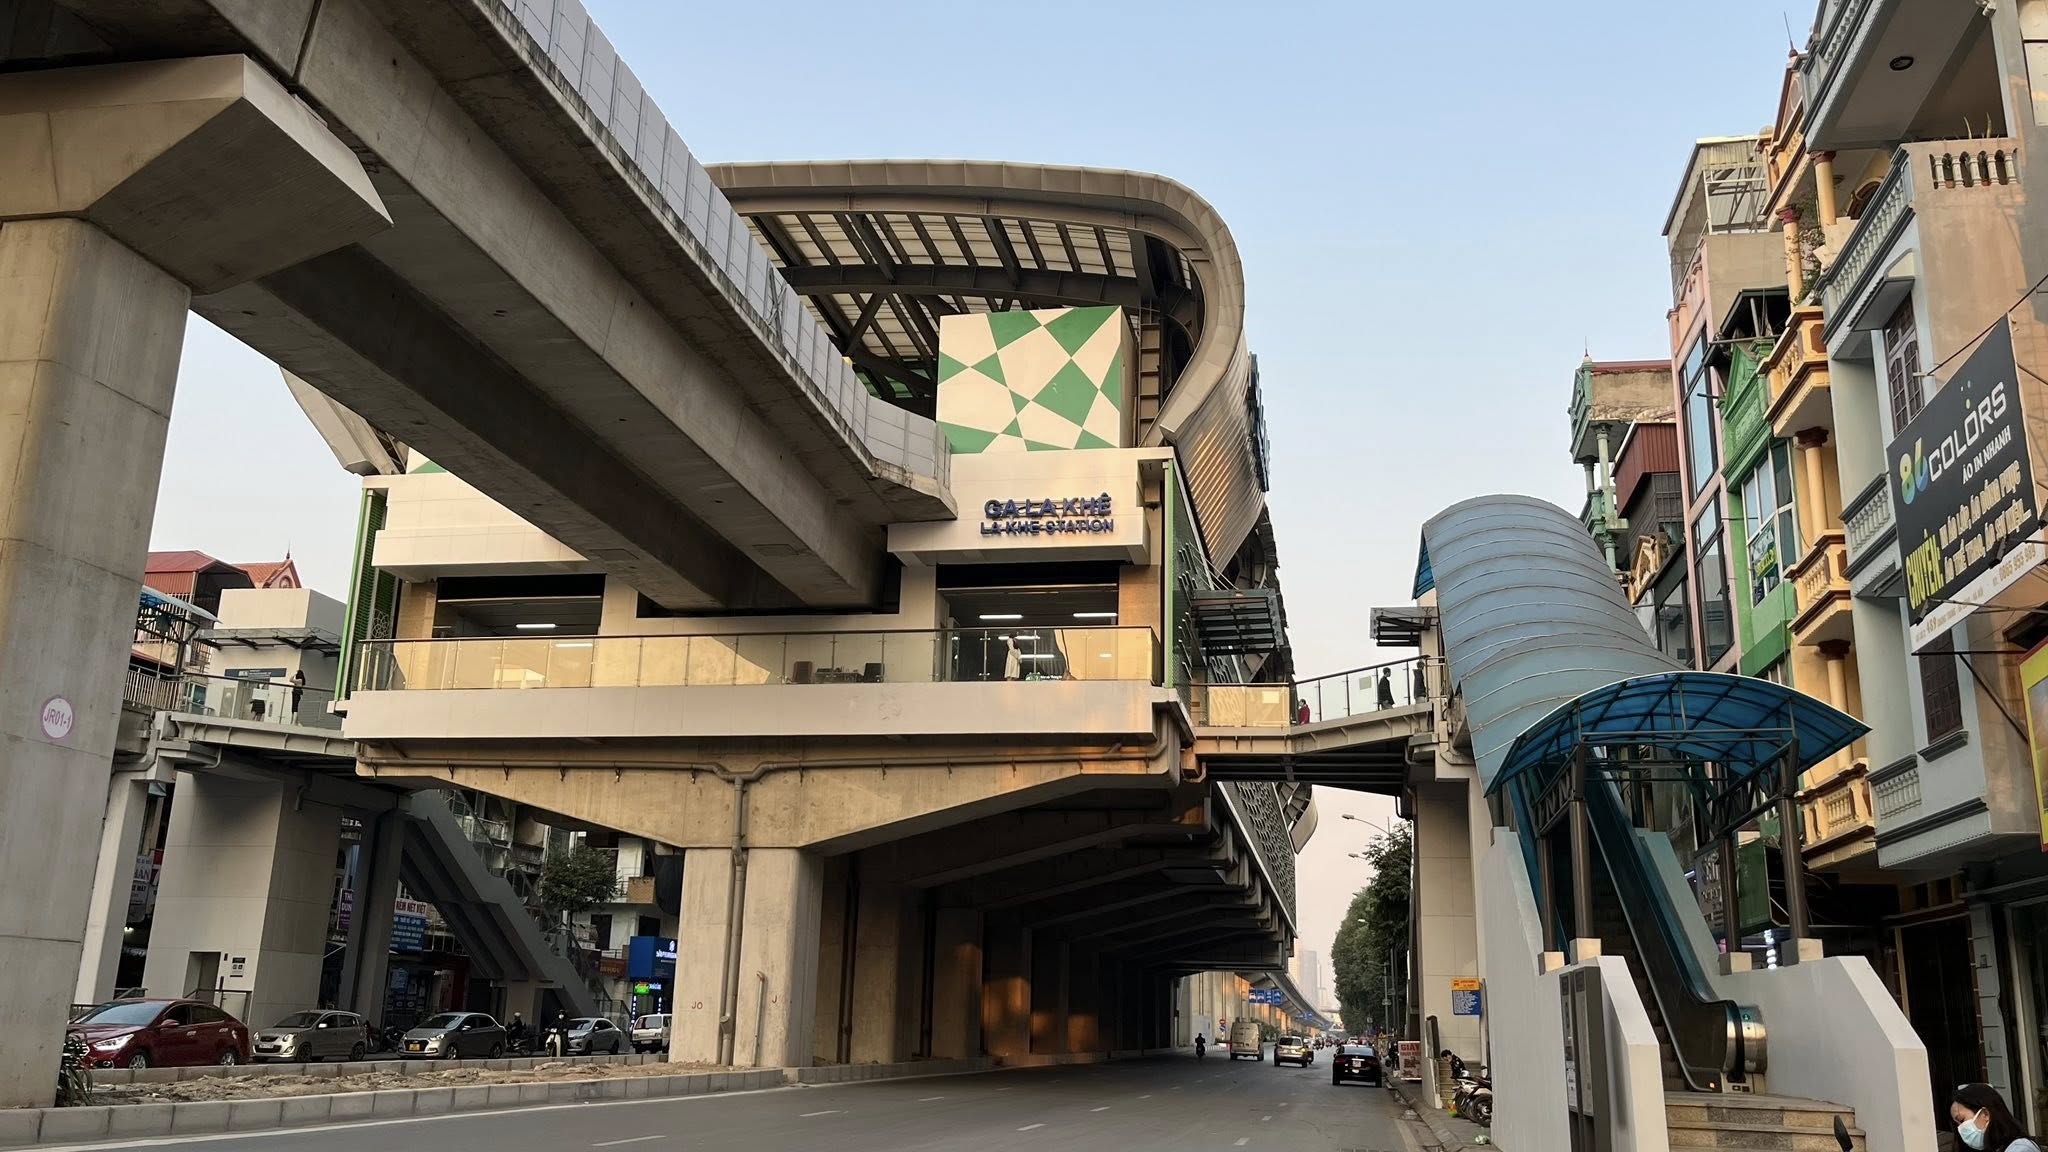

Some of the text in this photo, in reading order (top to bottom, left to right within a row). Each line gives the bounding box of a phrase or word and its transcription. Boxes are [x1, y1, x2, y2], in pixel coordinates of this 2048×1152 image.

[1928, 381, 2007, 482] COLORS
[1973, 453, 1983, 473] IN
[1983, 425, 2012, 464] NHANH
[984, 491, 1113, 520] GA LA KHÊ
[980, 518, 1114, 535] LA KHE STATION
